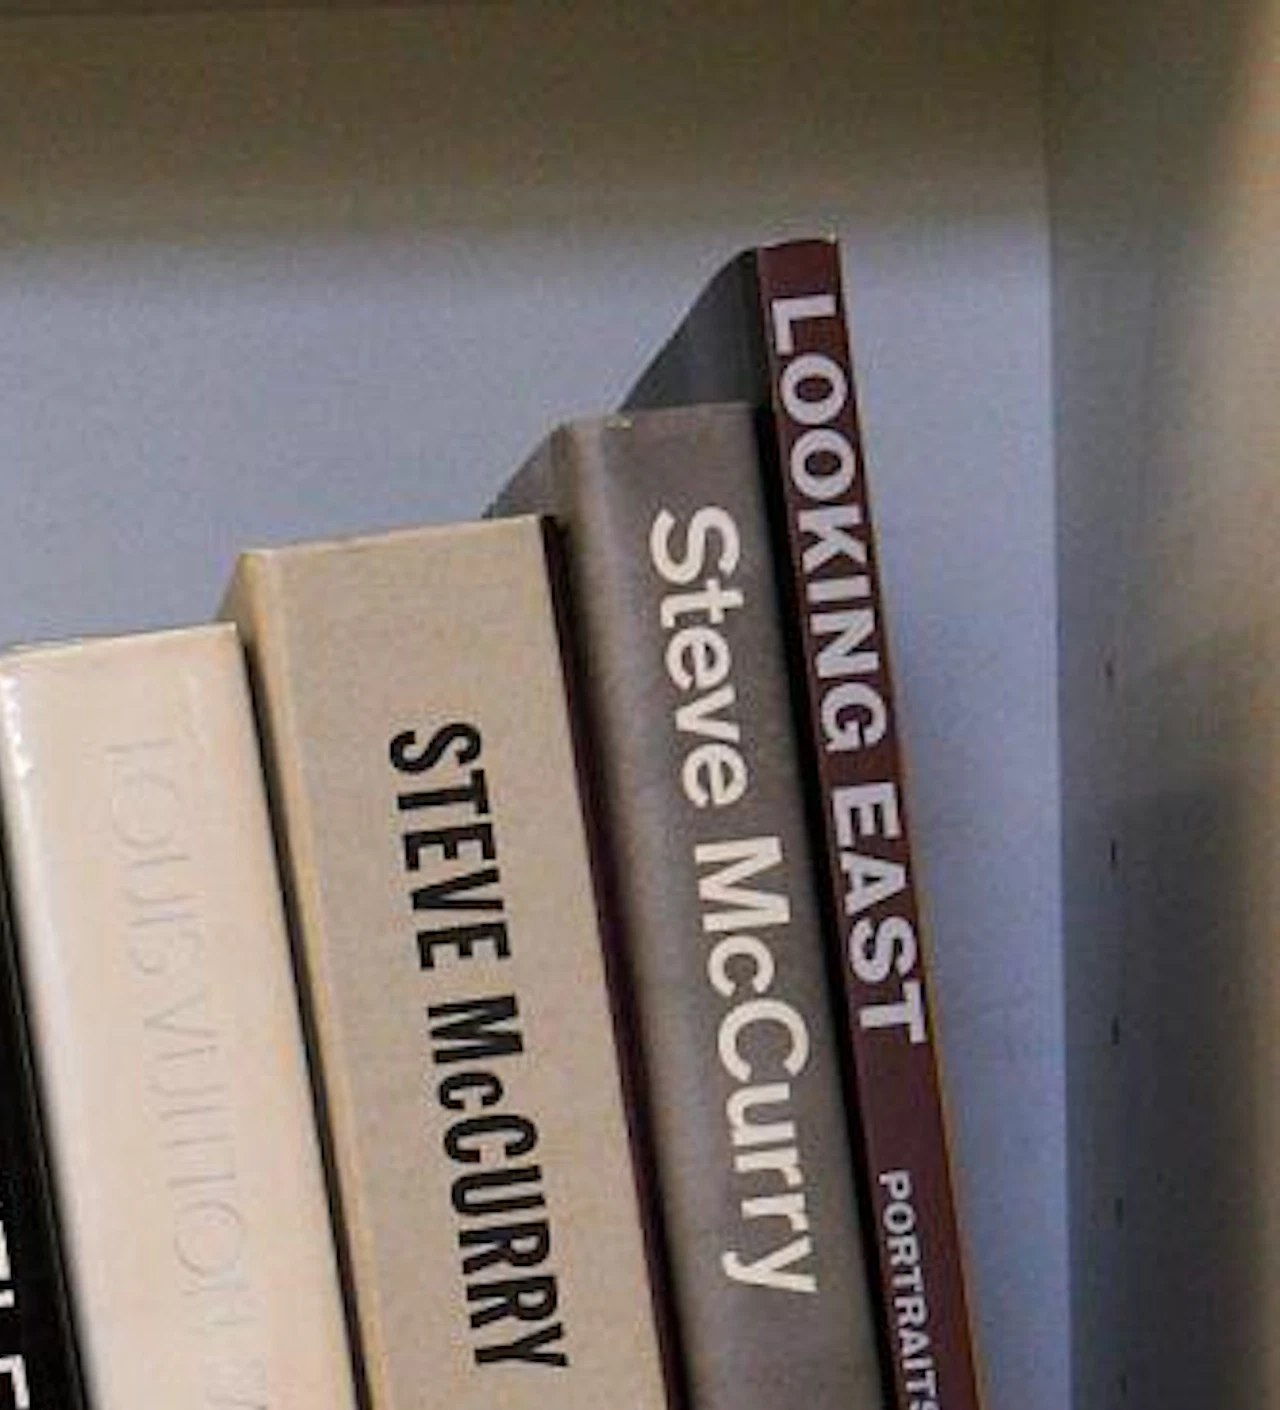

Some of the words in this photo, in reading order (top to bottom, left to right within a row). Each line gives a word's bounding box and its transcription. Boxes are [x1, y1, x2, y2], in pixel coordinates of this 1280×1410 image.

[648, 506, 751, 808] Steve
[769, 292, 888, 754] LOOKING
[830, 781, 927, 1045] EAST
[388, 721, 511, 970] STEVE
[428, 994, 569, 1369] McCURRY
[693, 834, 819, 1295] McCurry
